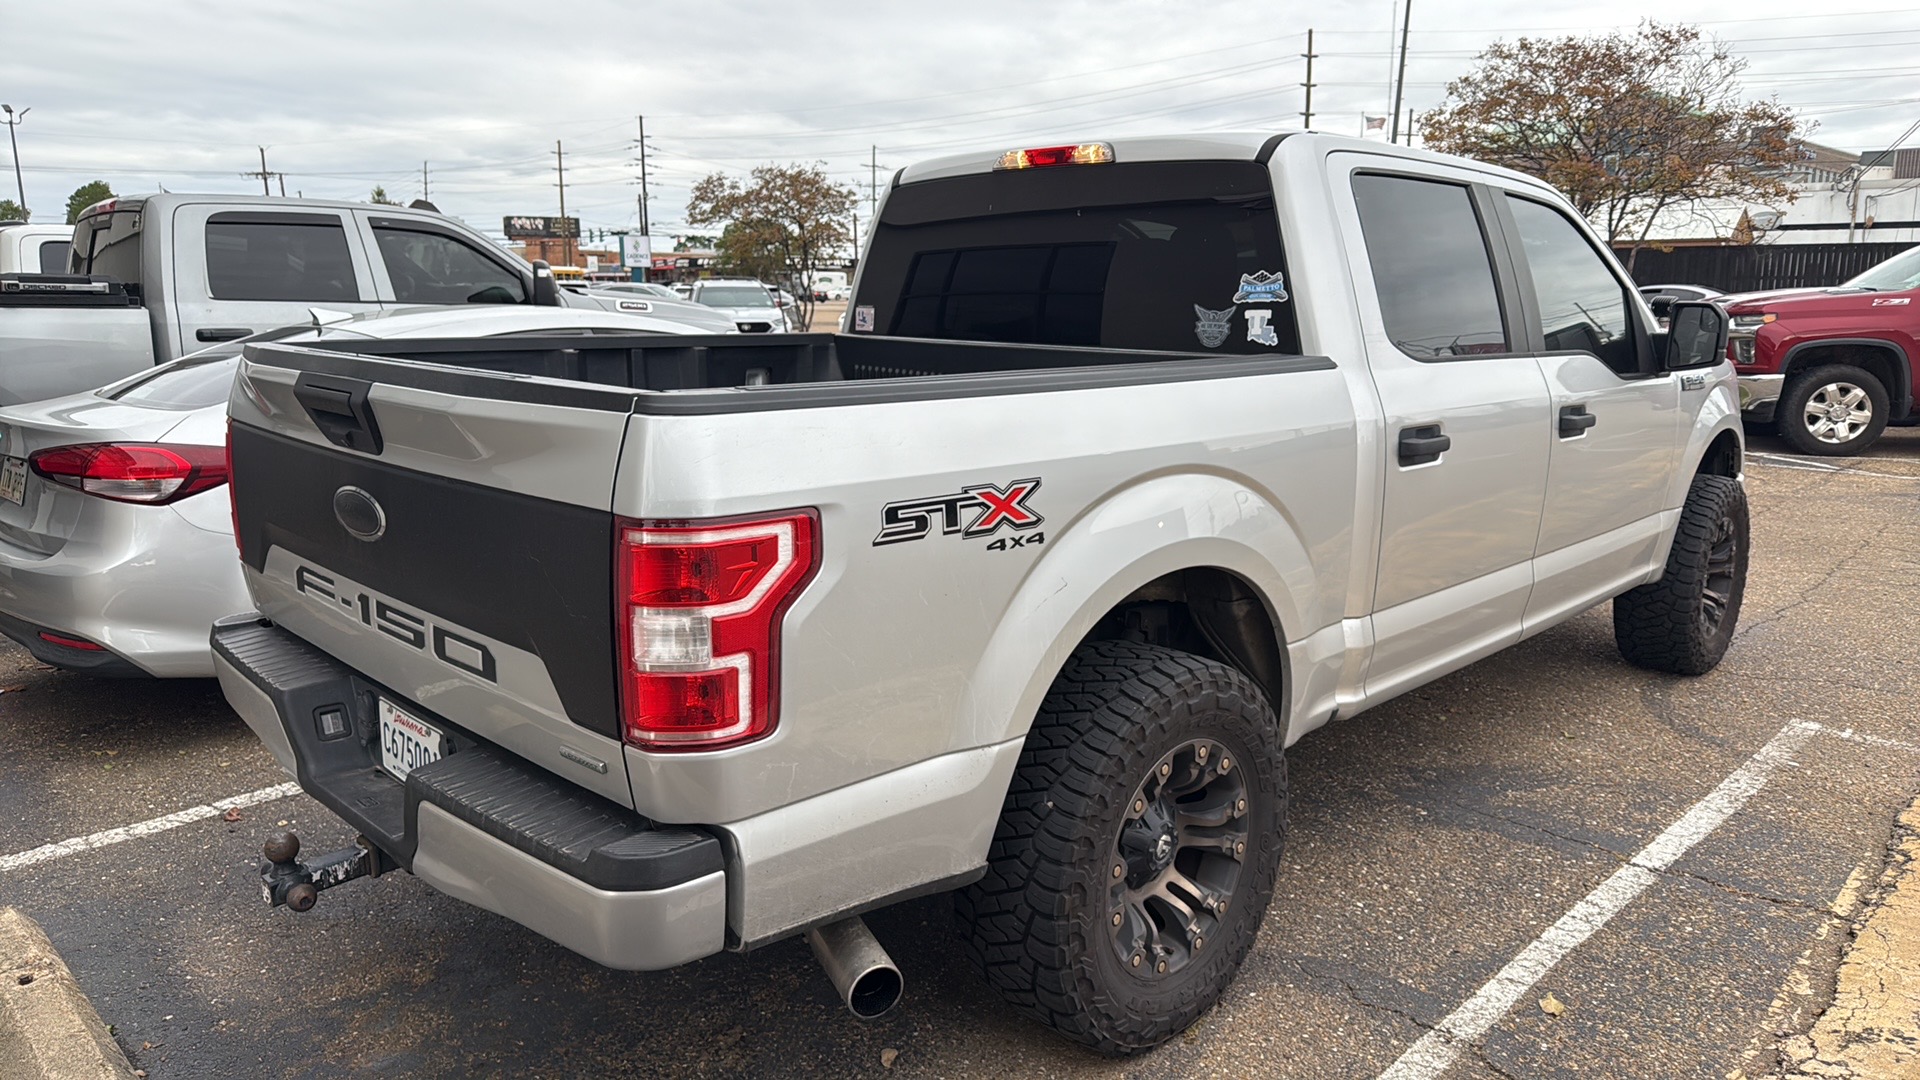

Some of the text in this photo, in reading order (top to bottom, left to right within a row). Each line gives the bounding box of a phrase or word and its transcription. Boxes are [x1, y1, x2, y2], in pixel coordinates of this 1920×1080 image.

[1243, 284, 1280, 292] PALMETTO
[872, 476, 1045, 547] STX
[295, 564, 498, 683] F-150
[383, 721, 439, 769] C67500
[393, 710, 427, 738] Louisiana
